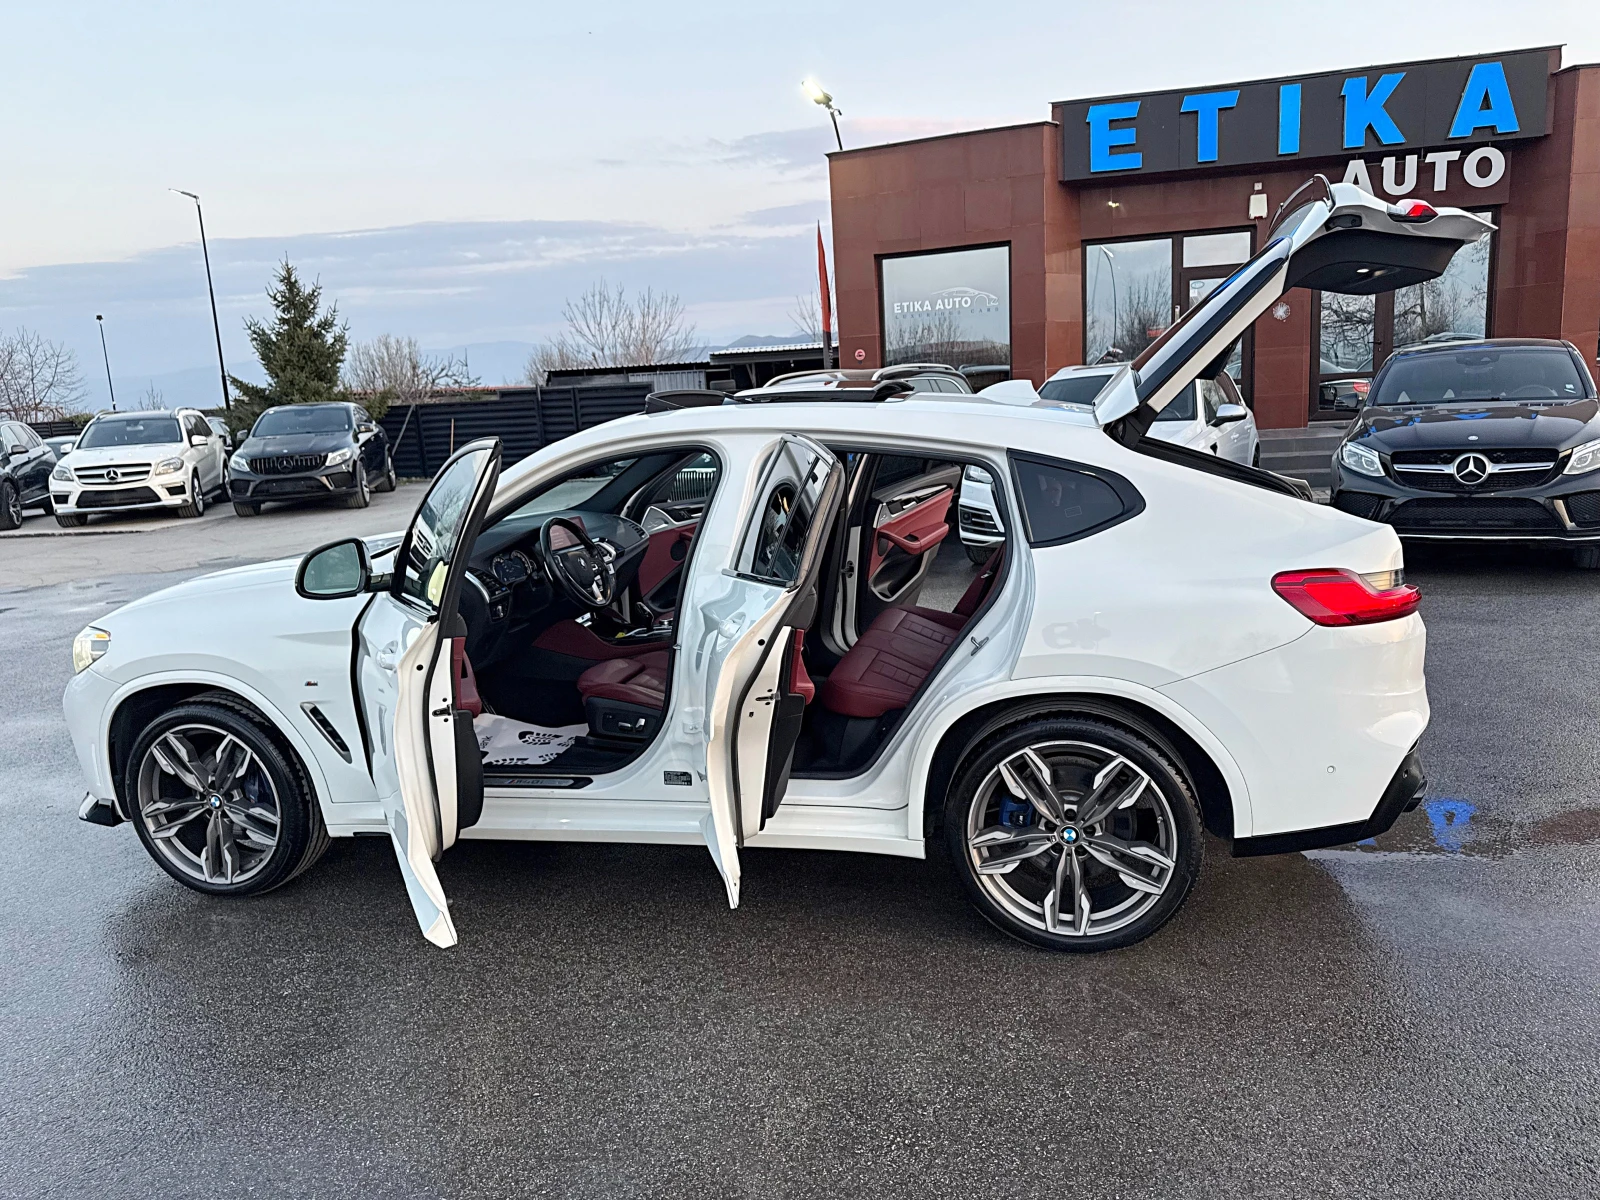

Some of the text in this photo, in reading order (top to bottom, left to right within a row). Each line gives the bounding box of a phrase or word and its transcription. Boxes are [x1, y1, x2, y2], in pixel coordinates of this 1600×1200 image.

[1086, 61, 1521, 173] ETIKA
[1342, 147, 1506, 196] AUTO
[893, 296, 971, 313] ETIKA AUTO
